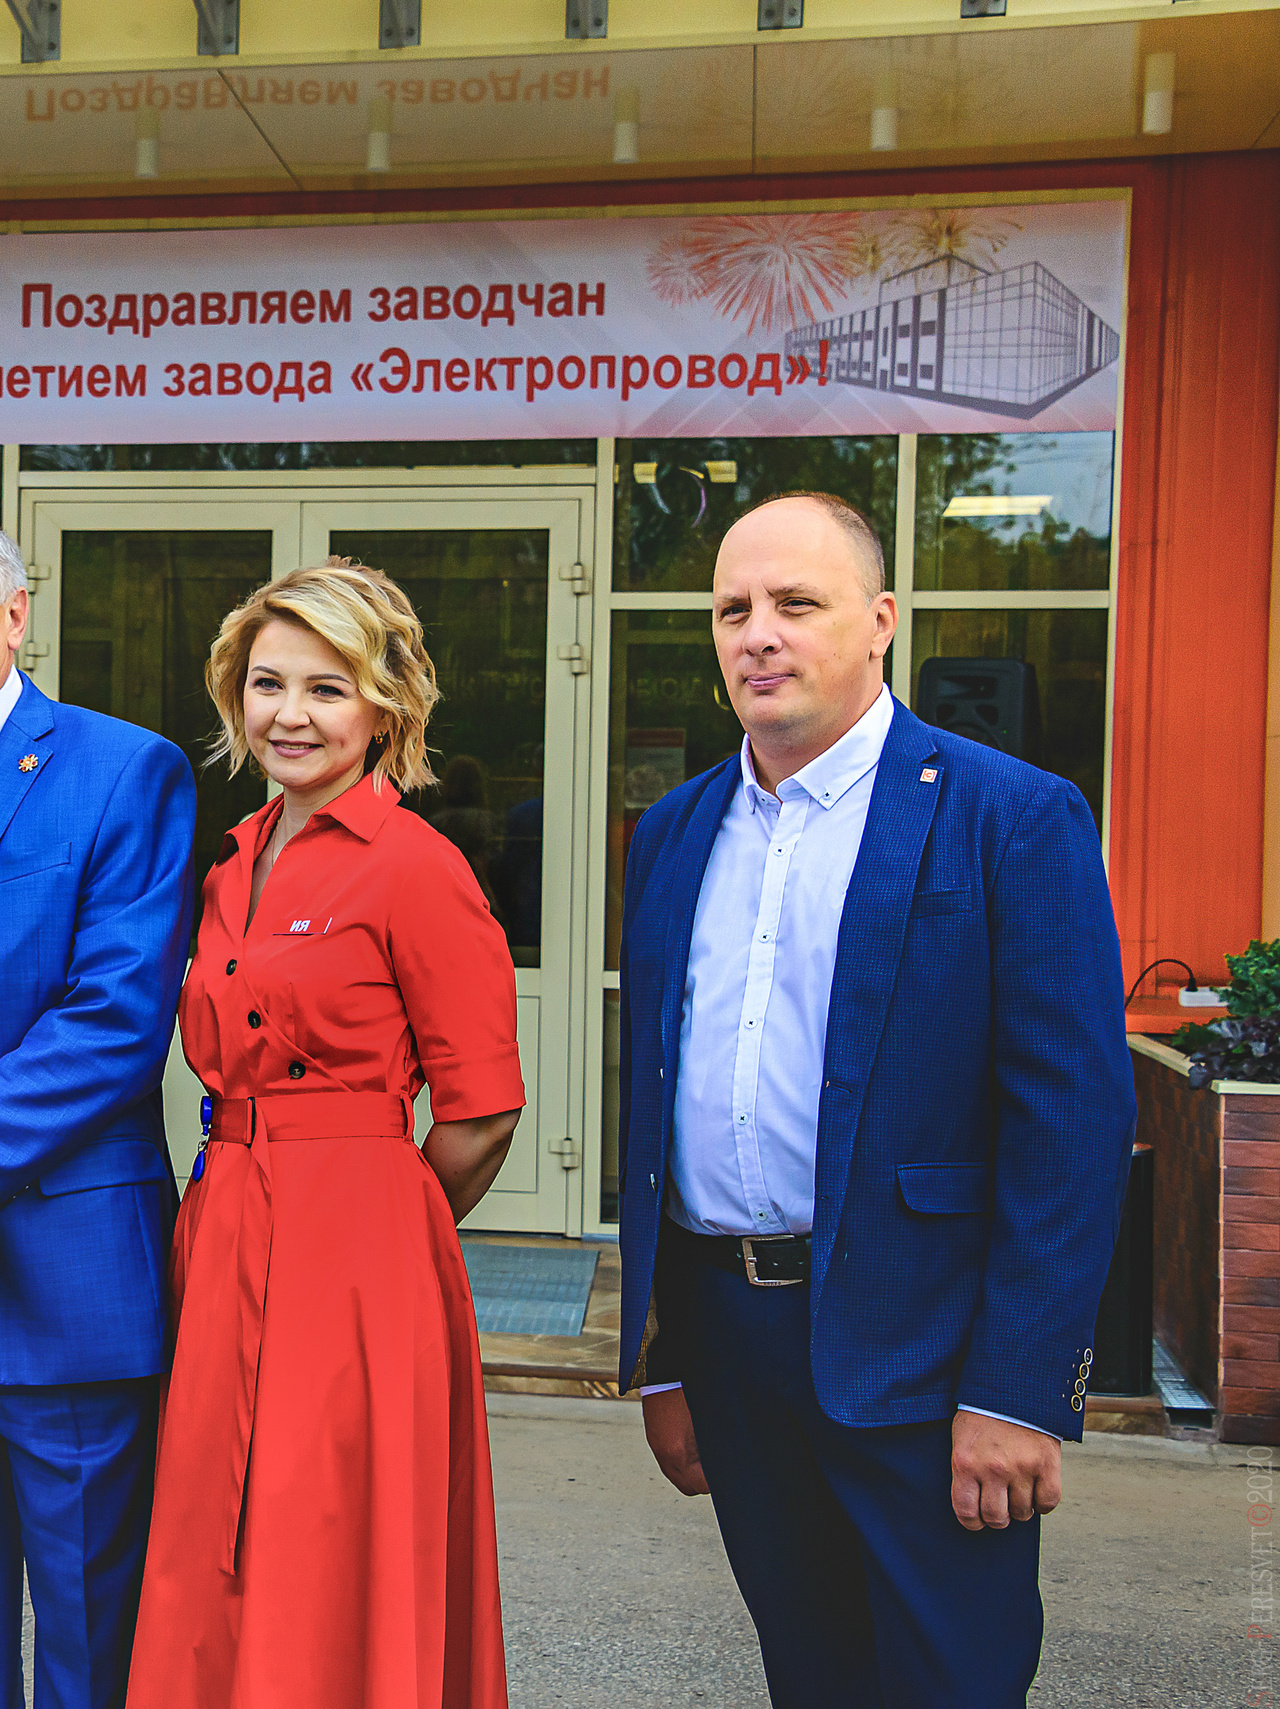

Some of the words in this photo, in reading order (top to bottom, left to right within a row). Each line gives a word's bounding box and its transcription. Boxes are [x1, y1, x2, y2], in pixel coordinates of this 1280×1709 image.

[21, 283, 352, 338] Поздравляем
[367, 281, 606, 327] заводчан
[162, 359, 333, 403] завода
[349, 339, 831, 402] «Электропровод»!
